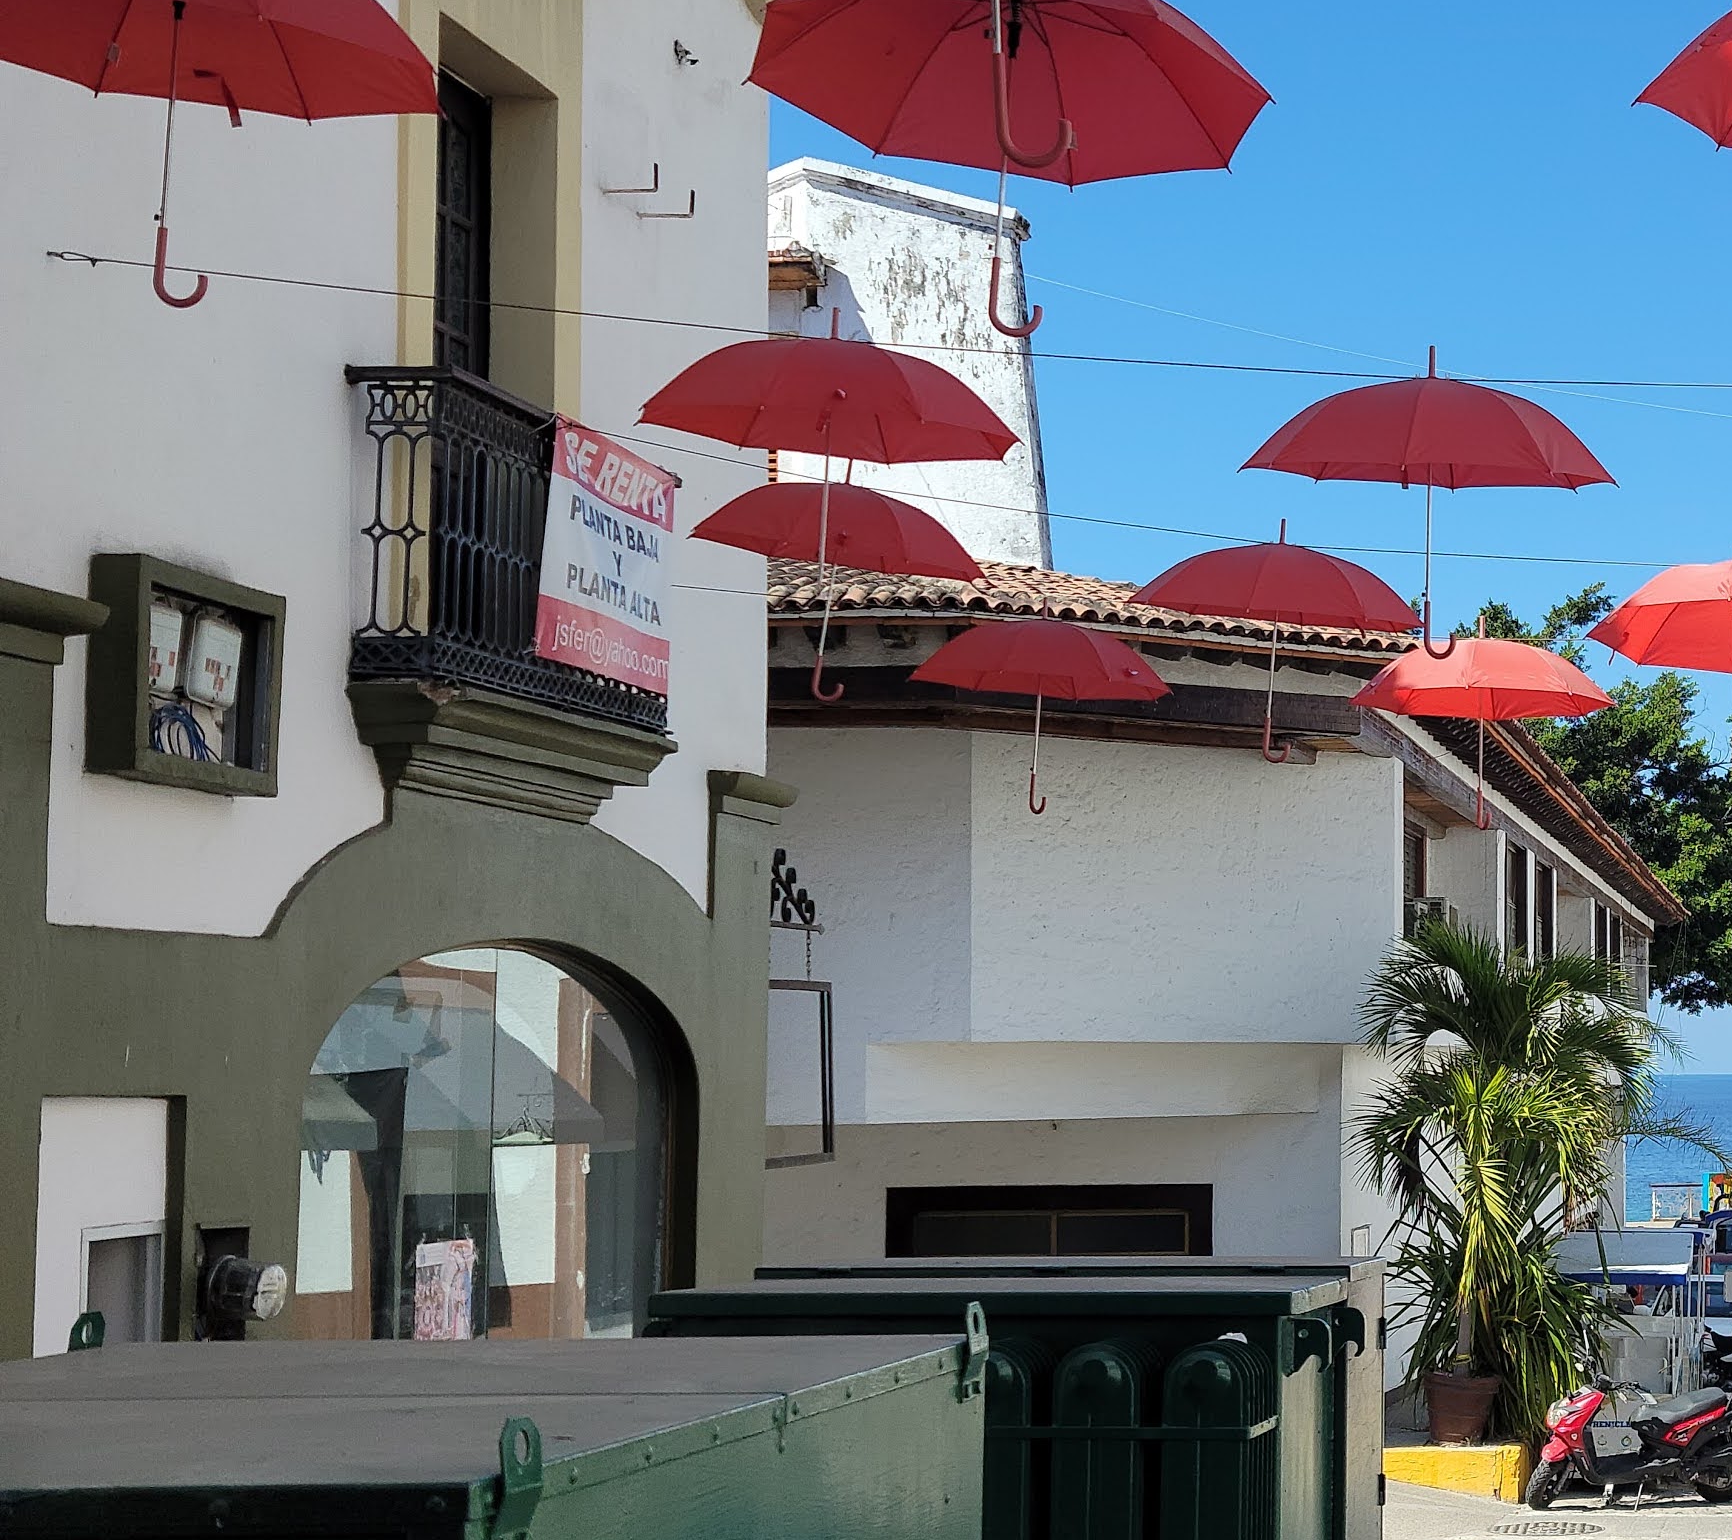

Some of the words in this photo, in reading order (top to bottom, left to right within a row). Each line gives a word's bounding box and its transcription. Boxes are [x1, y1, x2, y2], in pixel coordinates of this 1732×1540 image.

[563, 431, 600, 486] SE
[594, 451, 667, 523] RENTA
[569, 494, 623, 546] PLANTA
[625, 523, 660, 563] BAJA
[566, 563, 628, 612] PLANTA
[629, 592, 662, 626] ALTA
[611, 550, 623, 578] Y
[551, 614, 669, 679] jsfer@yahoo.com
